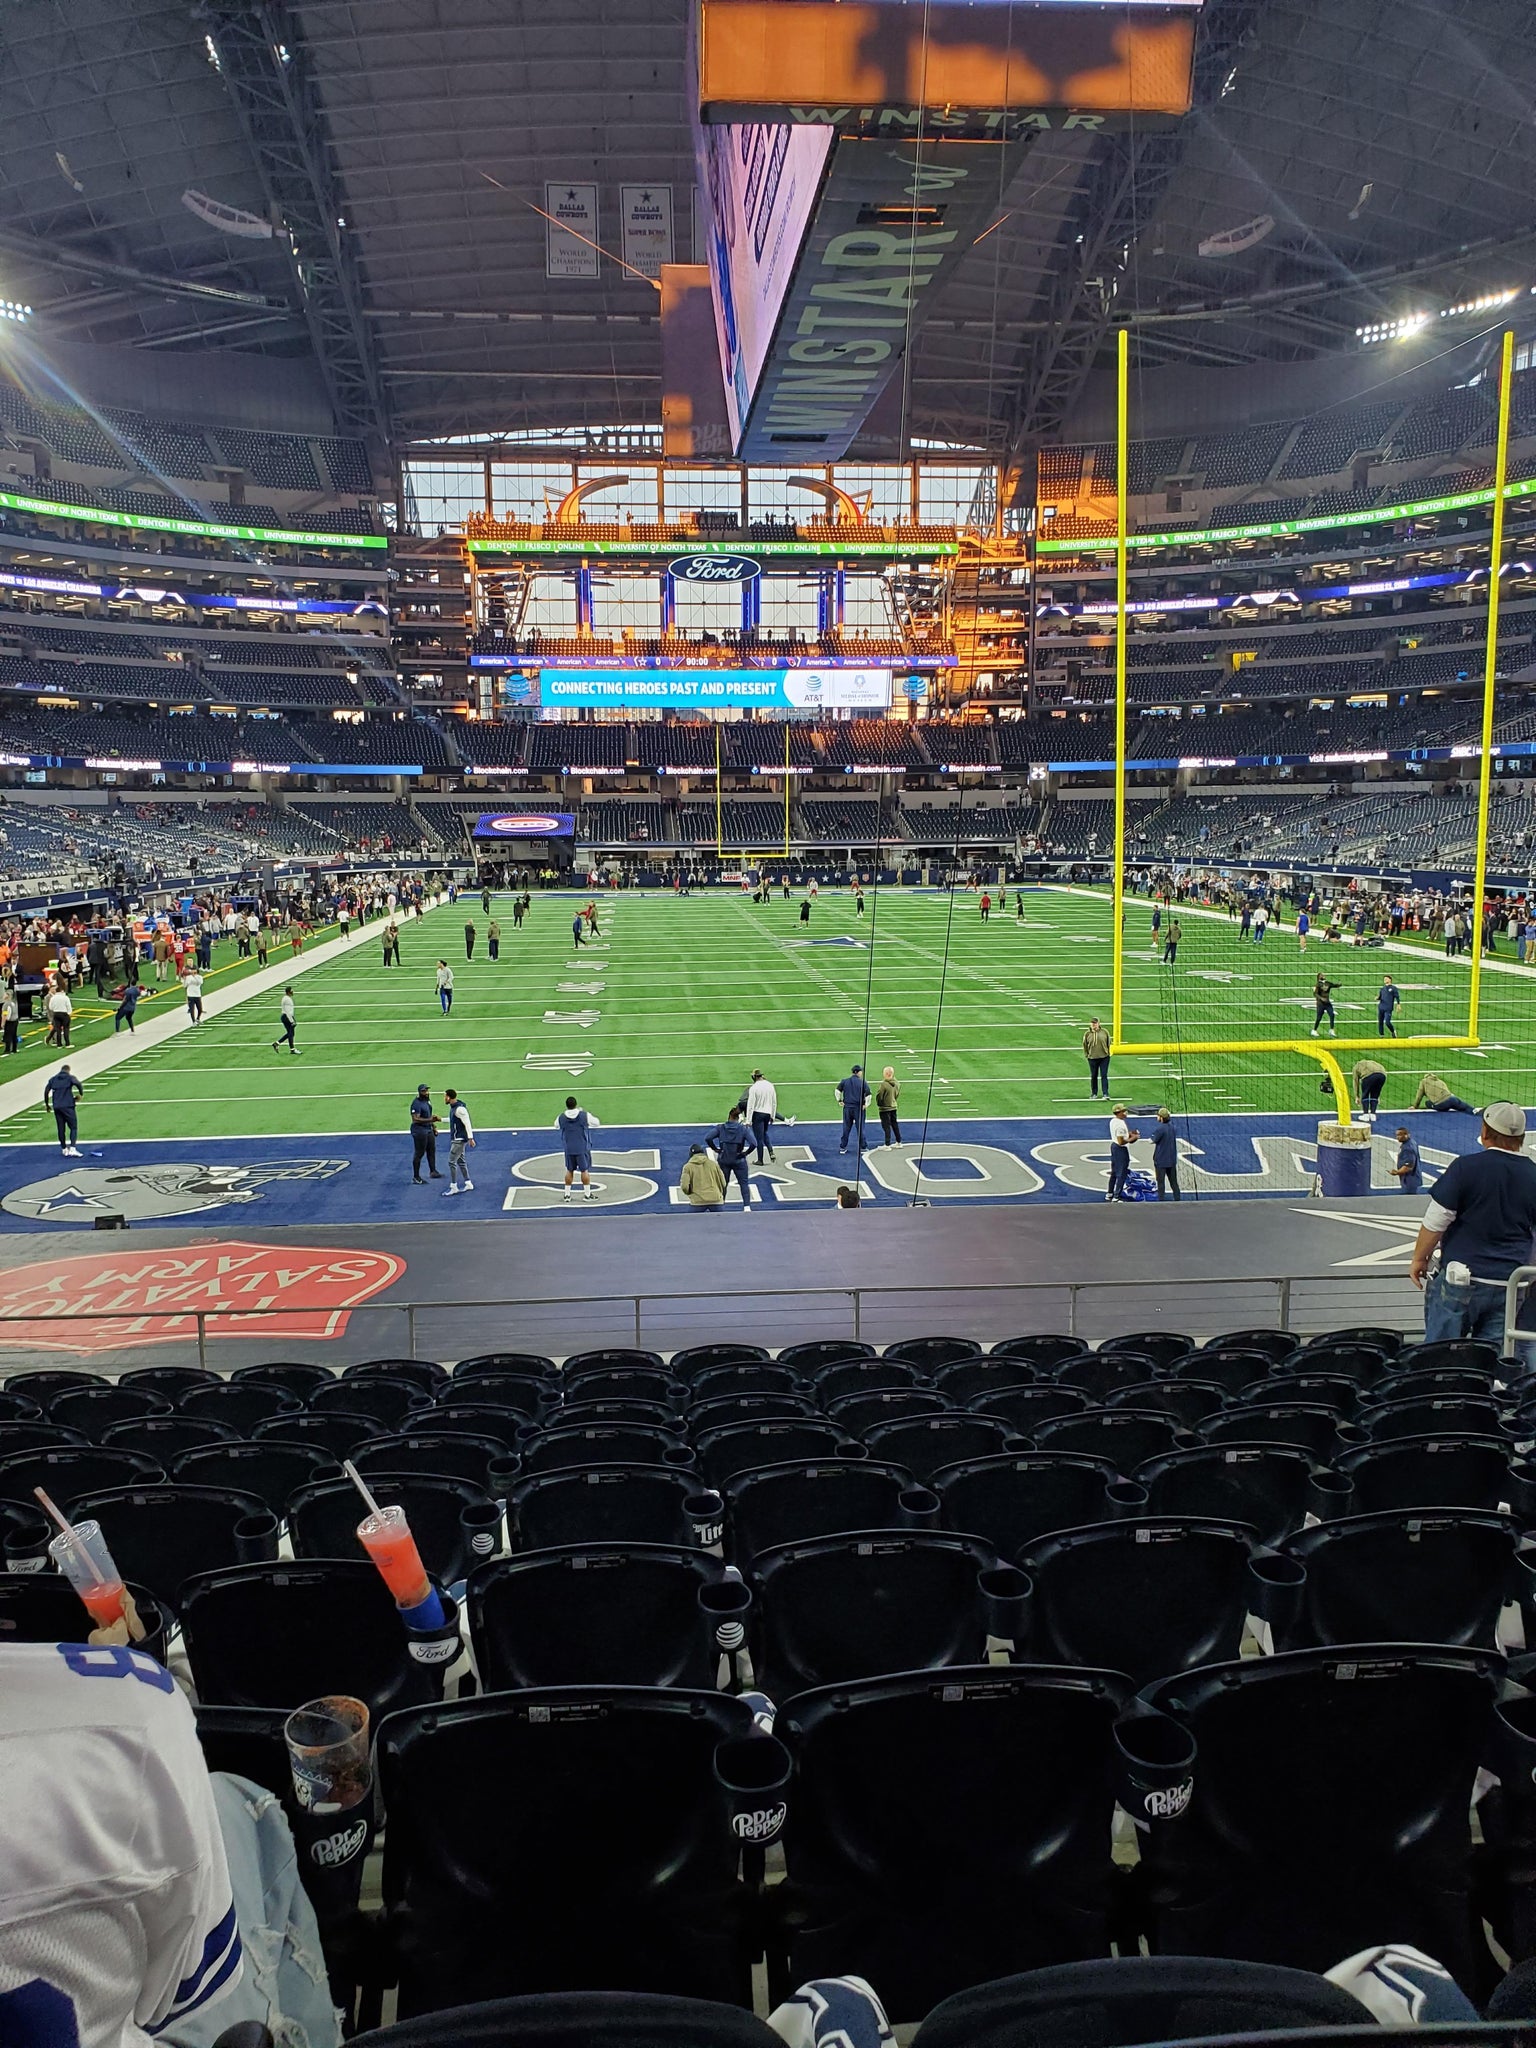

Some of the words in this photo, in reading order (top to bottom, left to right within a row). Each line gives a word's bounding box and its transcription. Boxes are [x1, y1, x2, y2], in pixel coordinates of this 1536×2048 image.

[790, 107, 1107, 133] WINSTAR
[559, 203, 585, 211] DALLAS
[634, 205, 660, 213] DALLAS
[556, 211, 588, 219] COWBOYS
[762, 228, 957, 436] WINSTAR
[16, 499, 58, 514] UNIVERSITY
[59, 506, 69, 515] OF
[70, 507, 97, 520] NORTH
[98, 513, 119, 522] TEXAS
[1413, 502, 1446, 514] DENTON
[1451, 495, 1478, 506] FRISCO
[1295, 519, 1336, 530] UNIVERSITY
[1337, 516, 1347, 524] OF
[1349, 513, 1375, 523] NORTH
[1375, 510, 1395, 519] TEXAS
[137, 518, 171, 530] DENTON
[176, 521, 205, 533] FRISCO
[210, 525, 239, 537] ONLINE
[1174, 533, 1205, 542] DENTON
[1211, 529, 1238, 539] FRISCO
[1244, 526, 1272, 535] ONLINE
[263, 531, 303, 542] UNIVERSITY
[304, 535, 316, 543] OF
[317, 535, 342, 545] NORTH
[344, 537, 364, 546] TEXAS
[1059, 541, 1097, 549] UNIVERSITY
[1136, 536, 1156, 545] TEXAS
[487, 542, 518, 550] DENTON
[525, 542, 550, 550] FRISCO
[610, 543, 649, 551] UNIVERSITY
[650, 543, 658, 551] OF
[660, 543, 684, 551] NORTH
[725, 544, 756, 552] DENTON
[762, 544, 787, 552] FRISCO
[794, 544, 821, 552] ONLINE
[845, 544, 882, 552] UNIVERSITY
[686, 557, 744, 580] Ford
[655, 657, 661, 666] 0
[686, 657, 709, 666] 90:00
[772, 657, 778, 666] 0
[551, 682, 623, 695] CONNECTING
[625, 682, 668, 695] HEROES
[670, 682, 698, 695] PAST
[700, 682, 724, 695] AND
[726, 682, 777, 696] PRESENT
[262, 765, 290, 773] Mortgage
[854, 765, 906, 774] Blockchain.com
[1208, 759, 1236, 767] Mortgage
[473, 766, 529, 775] Blockchain.com
[571, 766, 625, 775] Blockchain.com
[3, 1251, 274, 1300] ARMY
[416, 1643, 451, 1660] Ford
[1166, 1784, 1185, 1800] Dr
[733, 1808, 784, 1838] Pepper
[753, 1808, 773, 1825] Dr
[331, 1828, 351, 1845] Dr
[312, 1825, 365, 1866] Pepper
